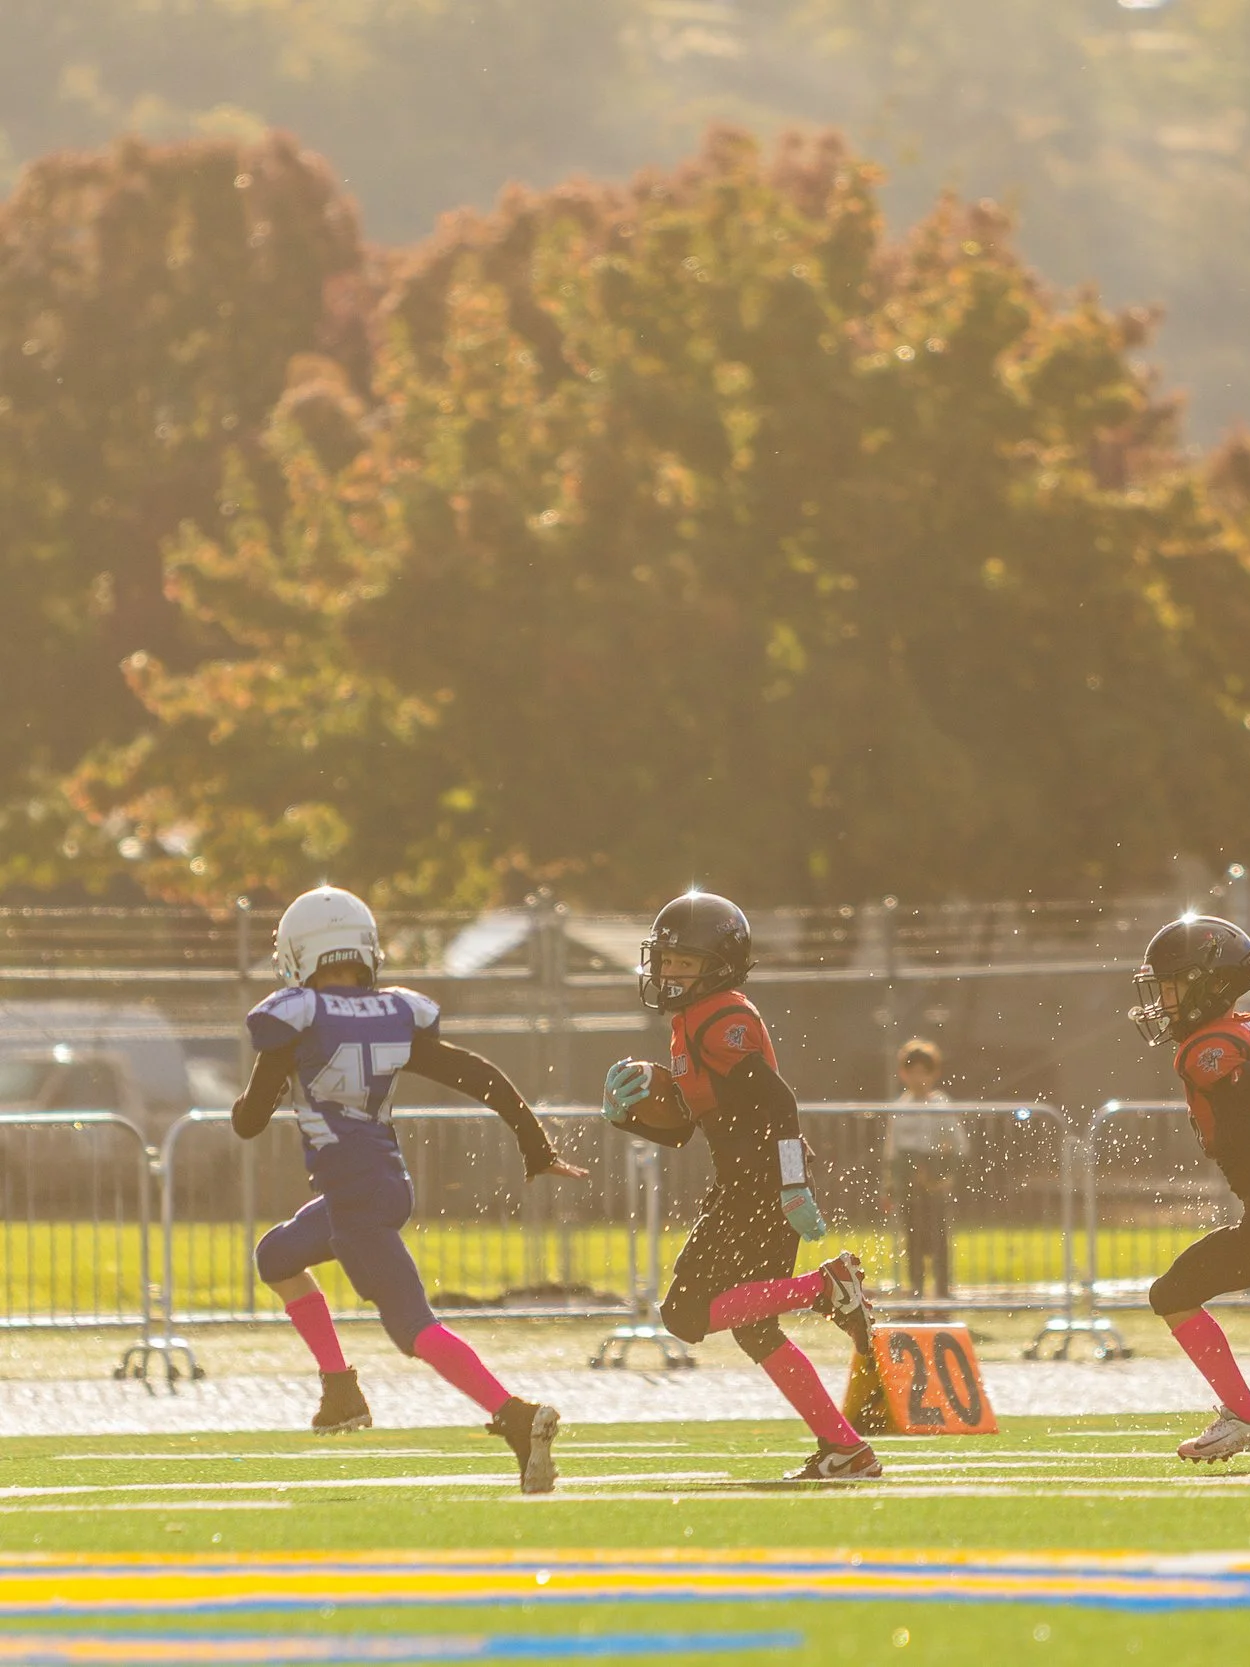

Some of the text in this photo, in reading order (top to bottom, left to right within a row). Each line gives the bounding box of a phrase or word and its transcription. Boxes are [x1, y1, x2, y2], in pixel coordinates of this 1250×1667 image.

[320, 993, 398, 1018] EBERT
[307, 1042, 412, 1122] 47
[889, 1331, 982, 1427] 20
